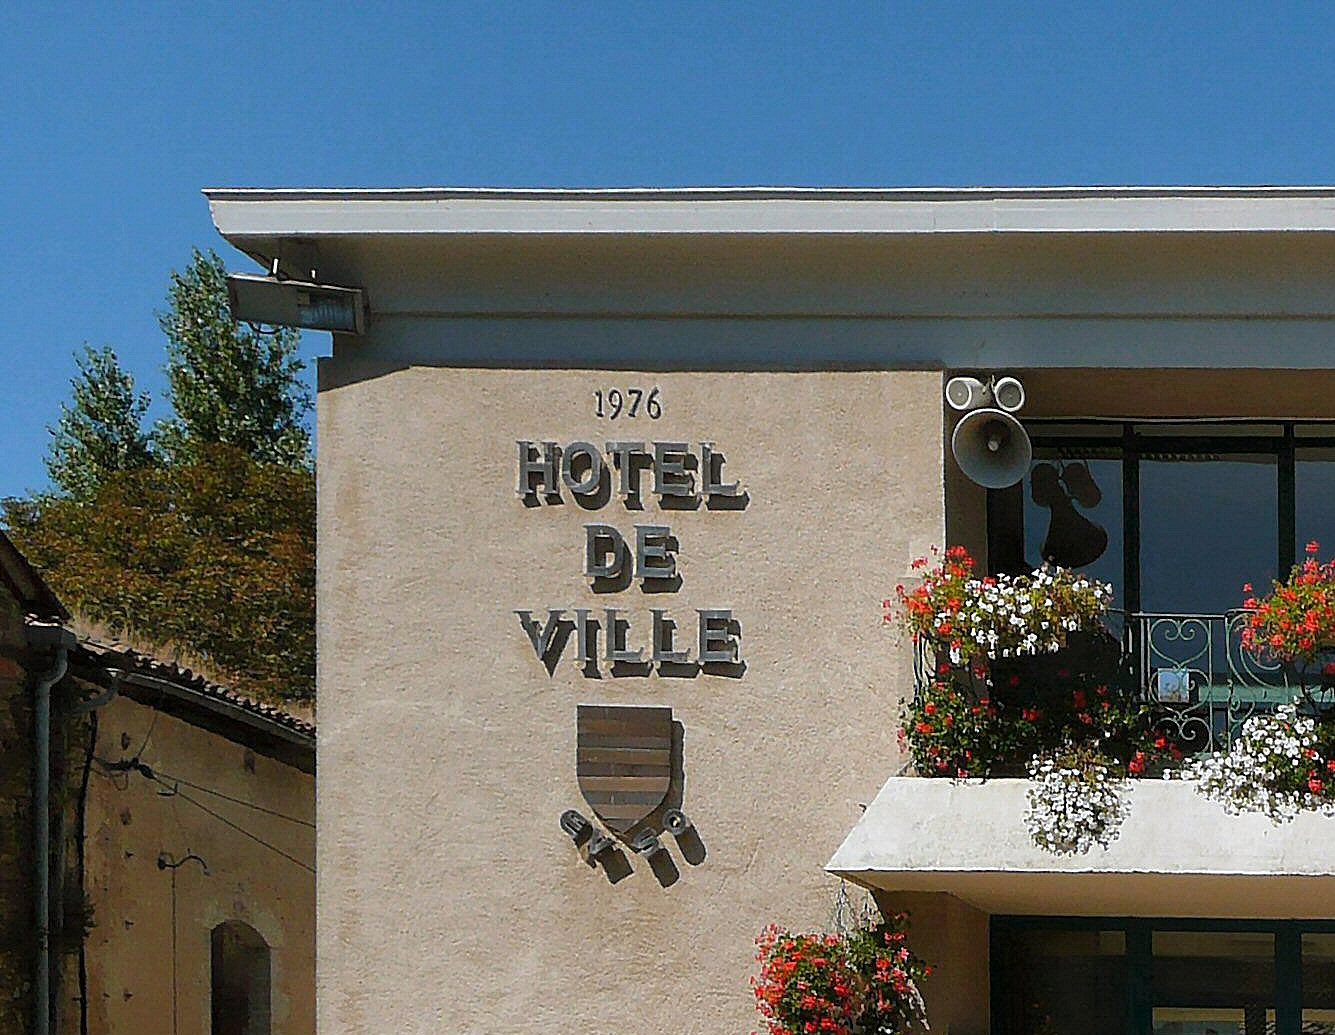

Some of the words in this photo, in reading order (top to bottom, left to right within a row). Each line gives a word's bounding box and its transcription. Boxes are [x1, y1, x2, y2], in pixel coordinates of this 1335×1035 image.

[594, 386, 662, 419] 1976
[515, 440, 741, 497] HOTEL
[583, 524, 677, 579] DE
[512, 608, 739, 664] VILLE
